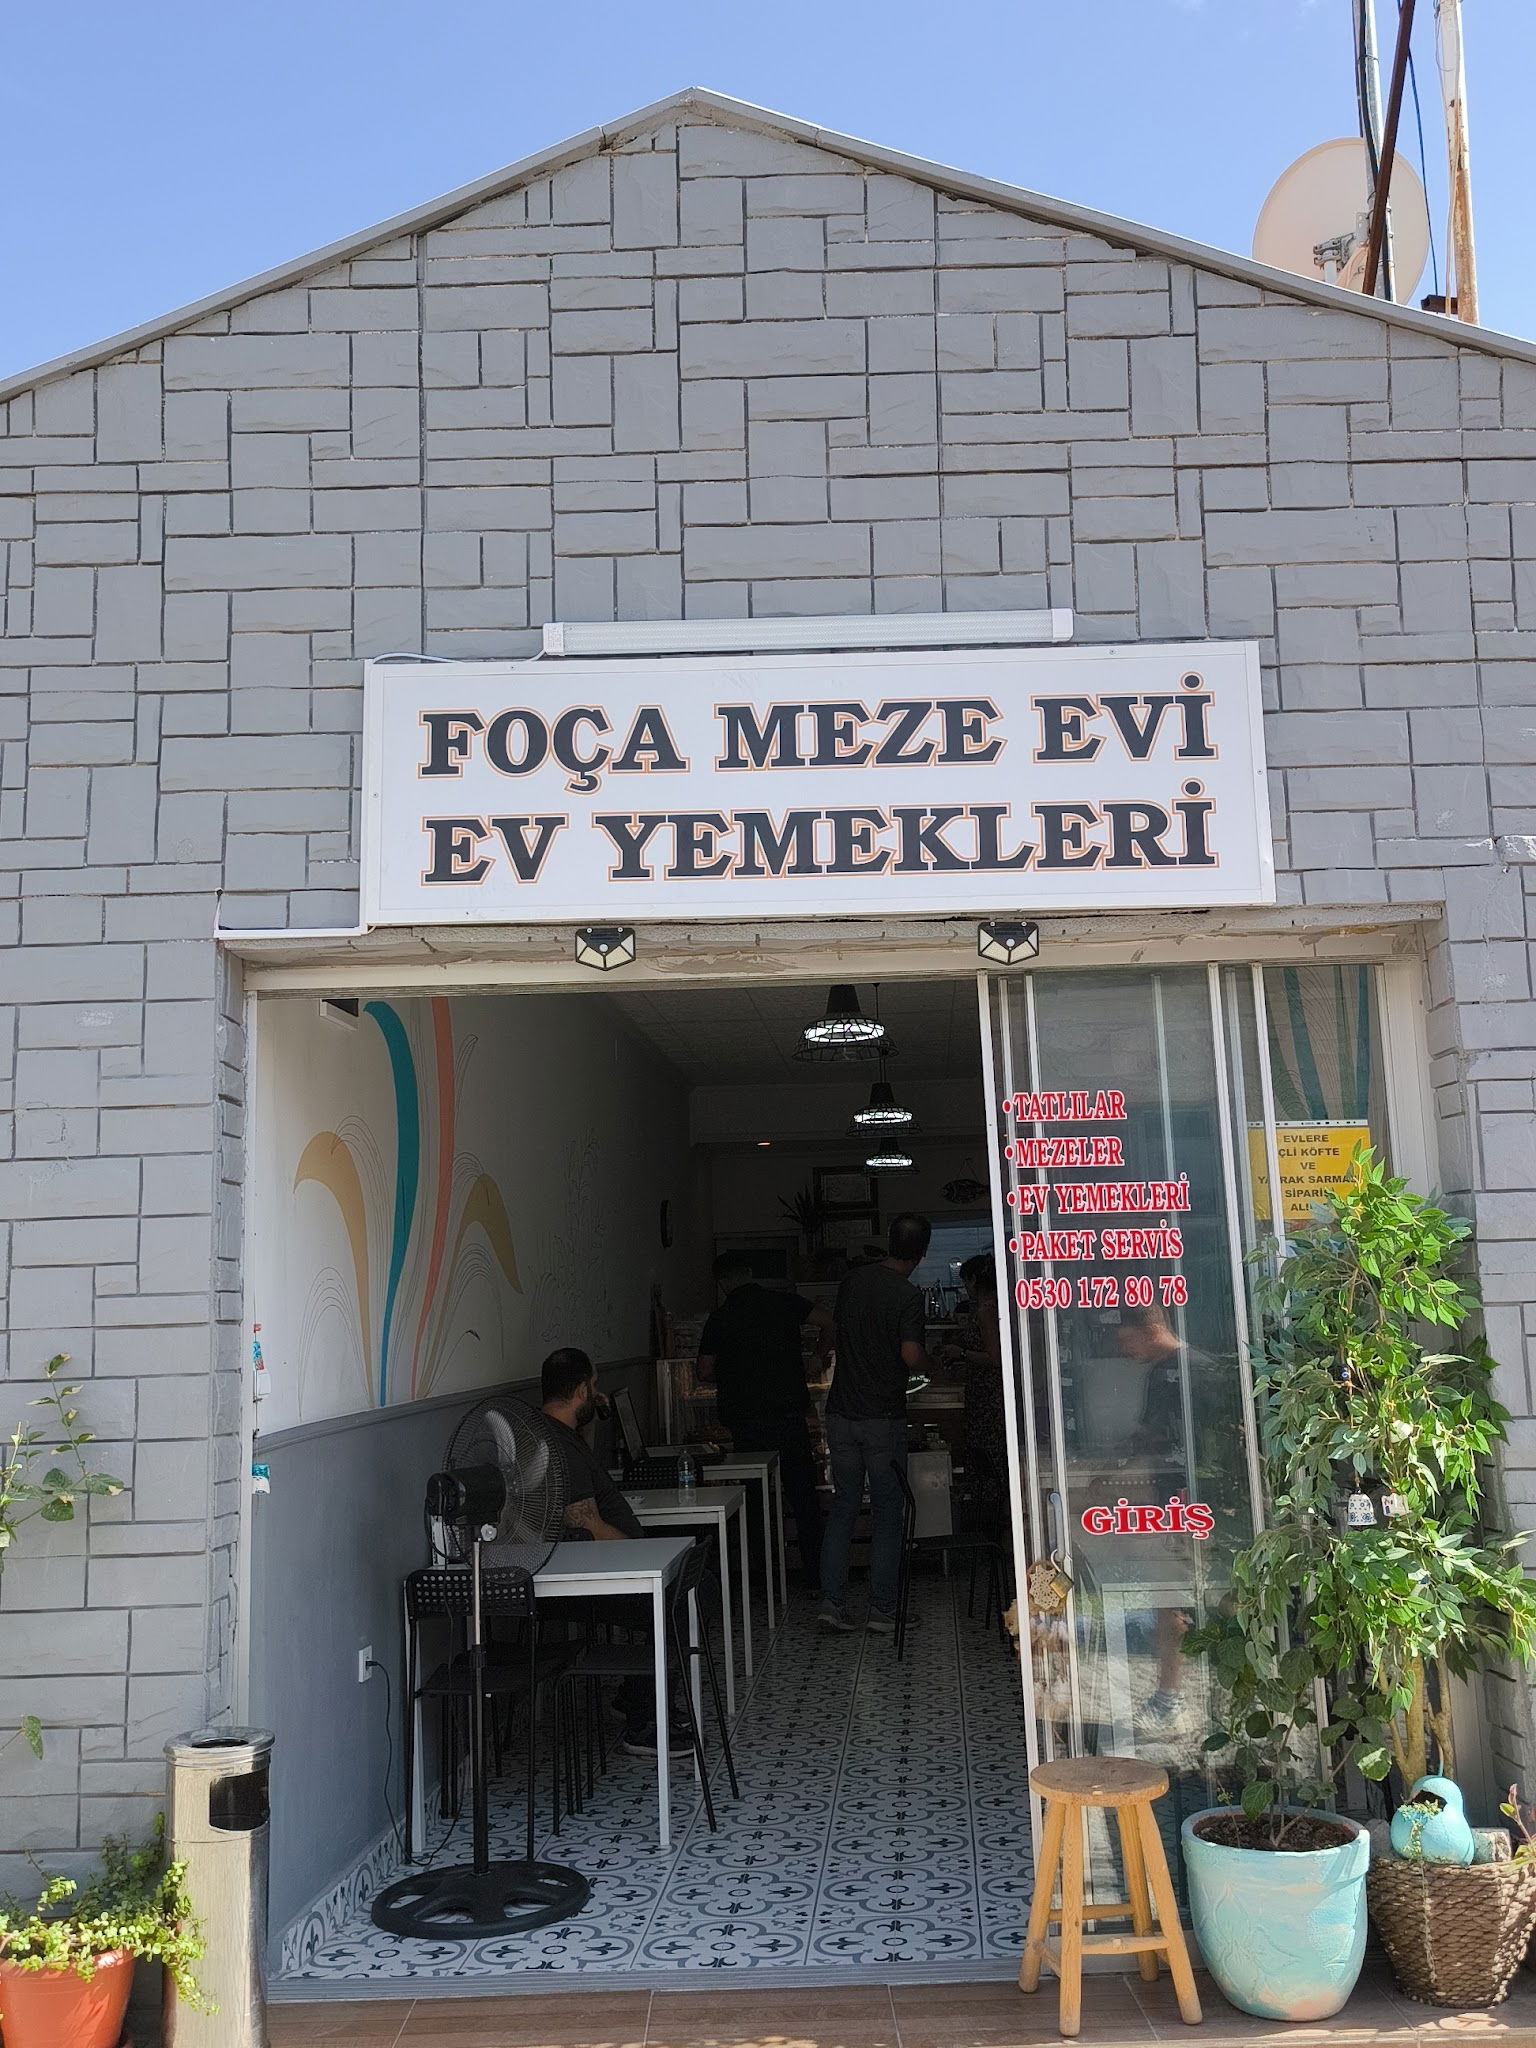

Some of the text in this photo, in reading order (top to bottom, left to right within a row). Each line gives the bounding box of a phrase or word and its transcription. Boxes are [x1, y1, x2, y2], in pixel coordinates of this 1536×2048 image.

[418, 671, 1219, 795] FOÇA MEZE EVİ
[420, 777, 1220, 886] EV YEMEKLERİ
[1013, 1090, 1127, 1122] TATLILAR
[1015, 1136, 1125, 1168] MEZELER
[1278, 1147, 1340, 1158] ÇLİ KÖFTE
[1283, 1134, 1329, 1143] EVLERE
[1257, 1175, 1304, 1184] YARAK
[1300, 1161, 1316, 1170] VE
[1017, 1172, 1191, 1215] EV YEMEKLERİ
[1285, 1187, 1335, 1198] SİPARİ
[1020, 1219, 1183, 1261] PAKET SERVİS
[1015, 1275, 1188, 1309] 0530 172 80 78
[1081, 1496, 1216, 1540] GİRİŞ
